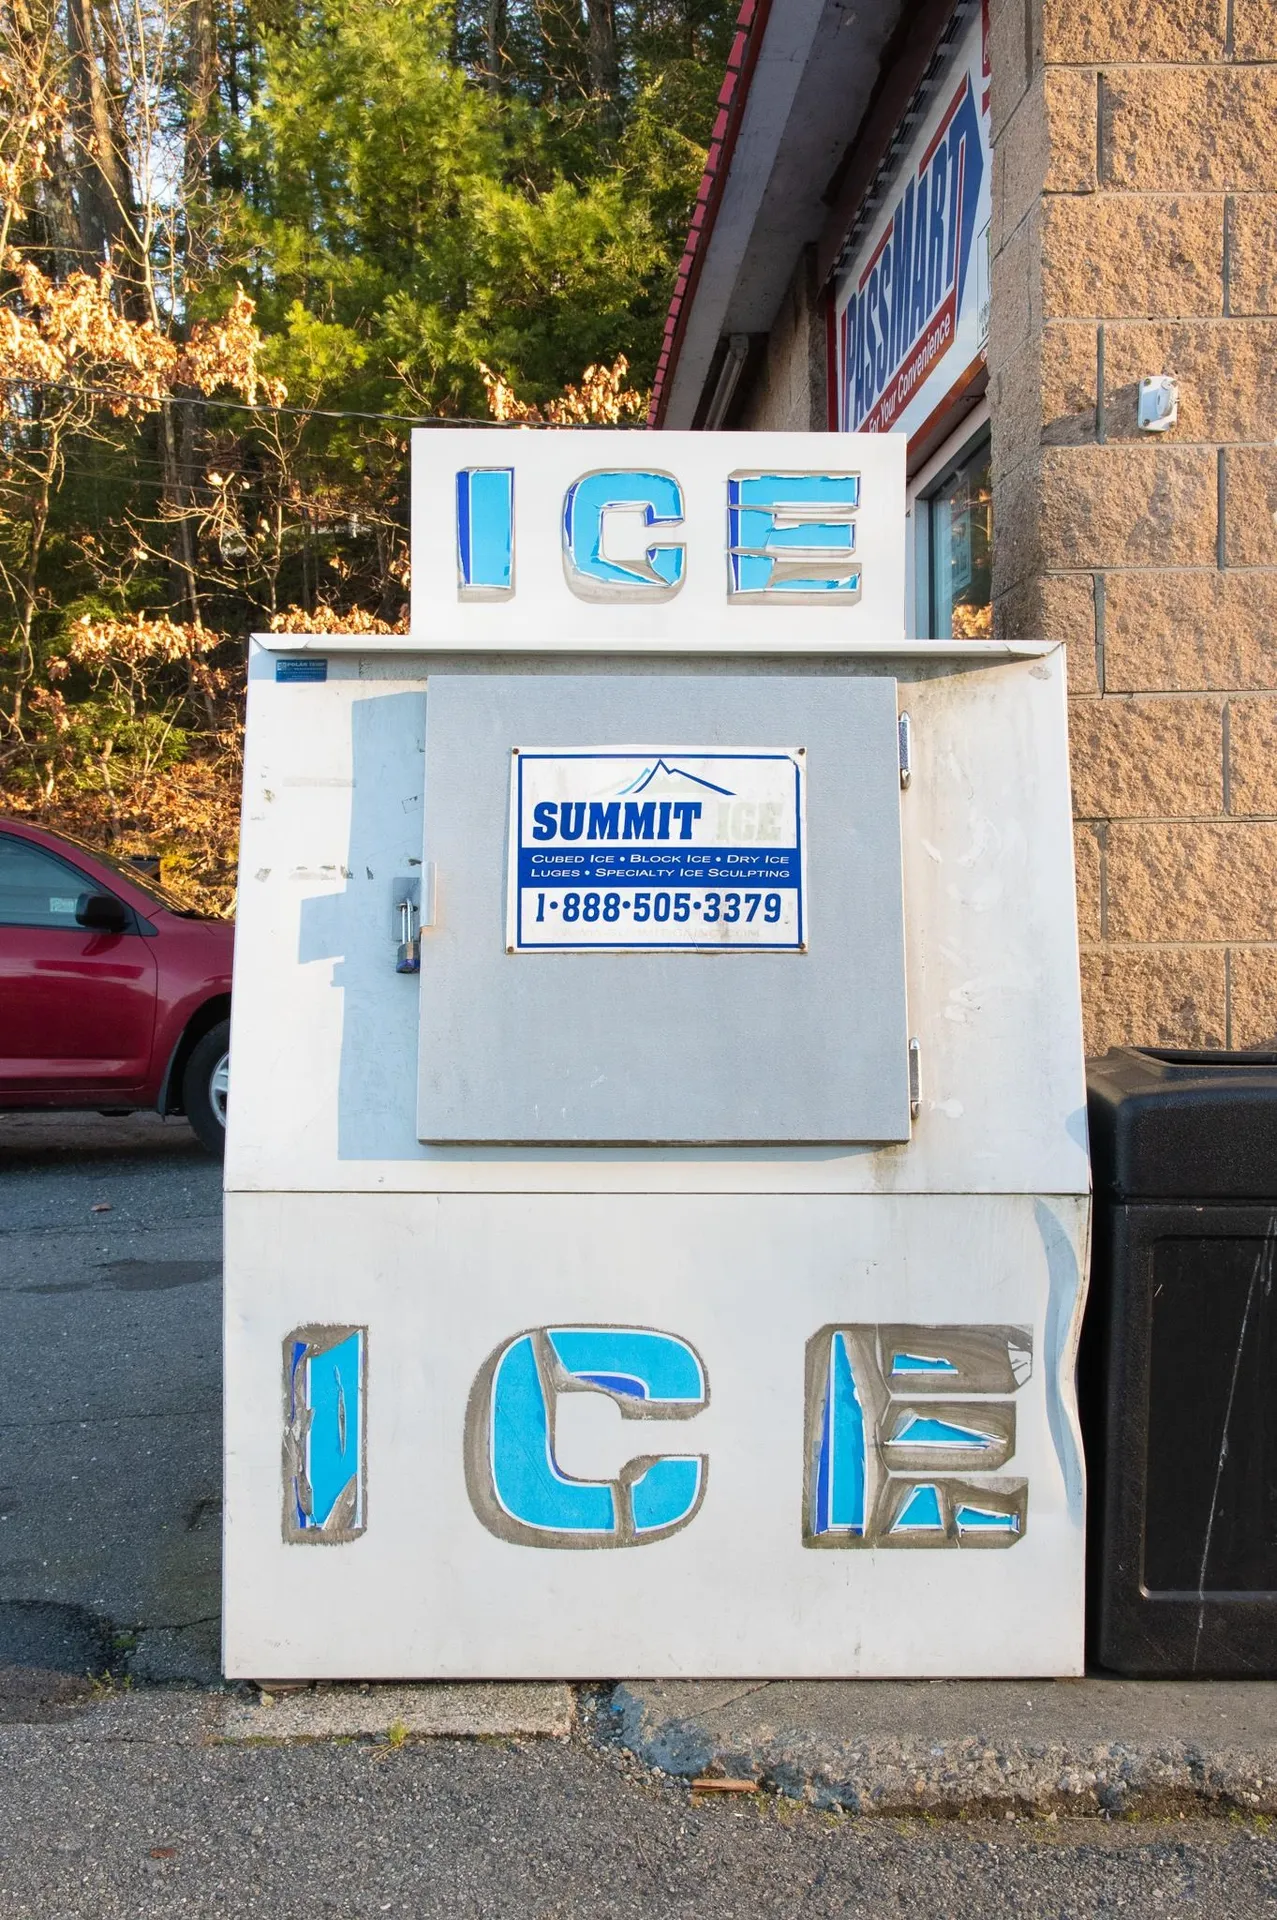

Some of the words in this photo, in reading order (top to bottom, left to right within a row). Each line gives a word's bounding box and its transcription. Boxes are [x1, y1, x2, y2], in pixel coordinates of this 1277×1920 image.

[845, 112, 967, 432] PASSMART
[880, 389, 897, 428] Your
[897, 312, 951, 404] Convenience
[456, 466, 862, 606] ICE
[531, 854, 585, 864] CUBED
[590, 854, 615, 864] ICE
[630, 854, 681, 864] BLOCK
[687, 854, 711, 864] ICE
[727, 854, 759, 864] DRY
[765, 855, 790, 864] ICE
[531, 868, 580, 878] LUGES
[595, 868, 675, 878] SPECIALTY
[680, 868, 704, 878] ICE
[708, 868, 790, 879] SCULPTING
[532, 801, 702, 841] SUMMIT
[282, 1323, 1034, 1549] ICE
